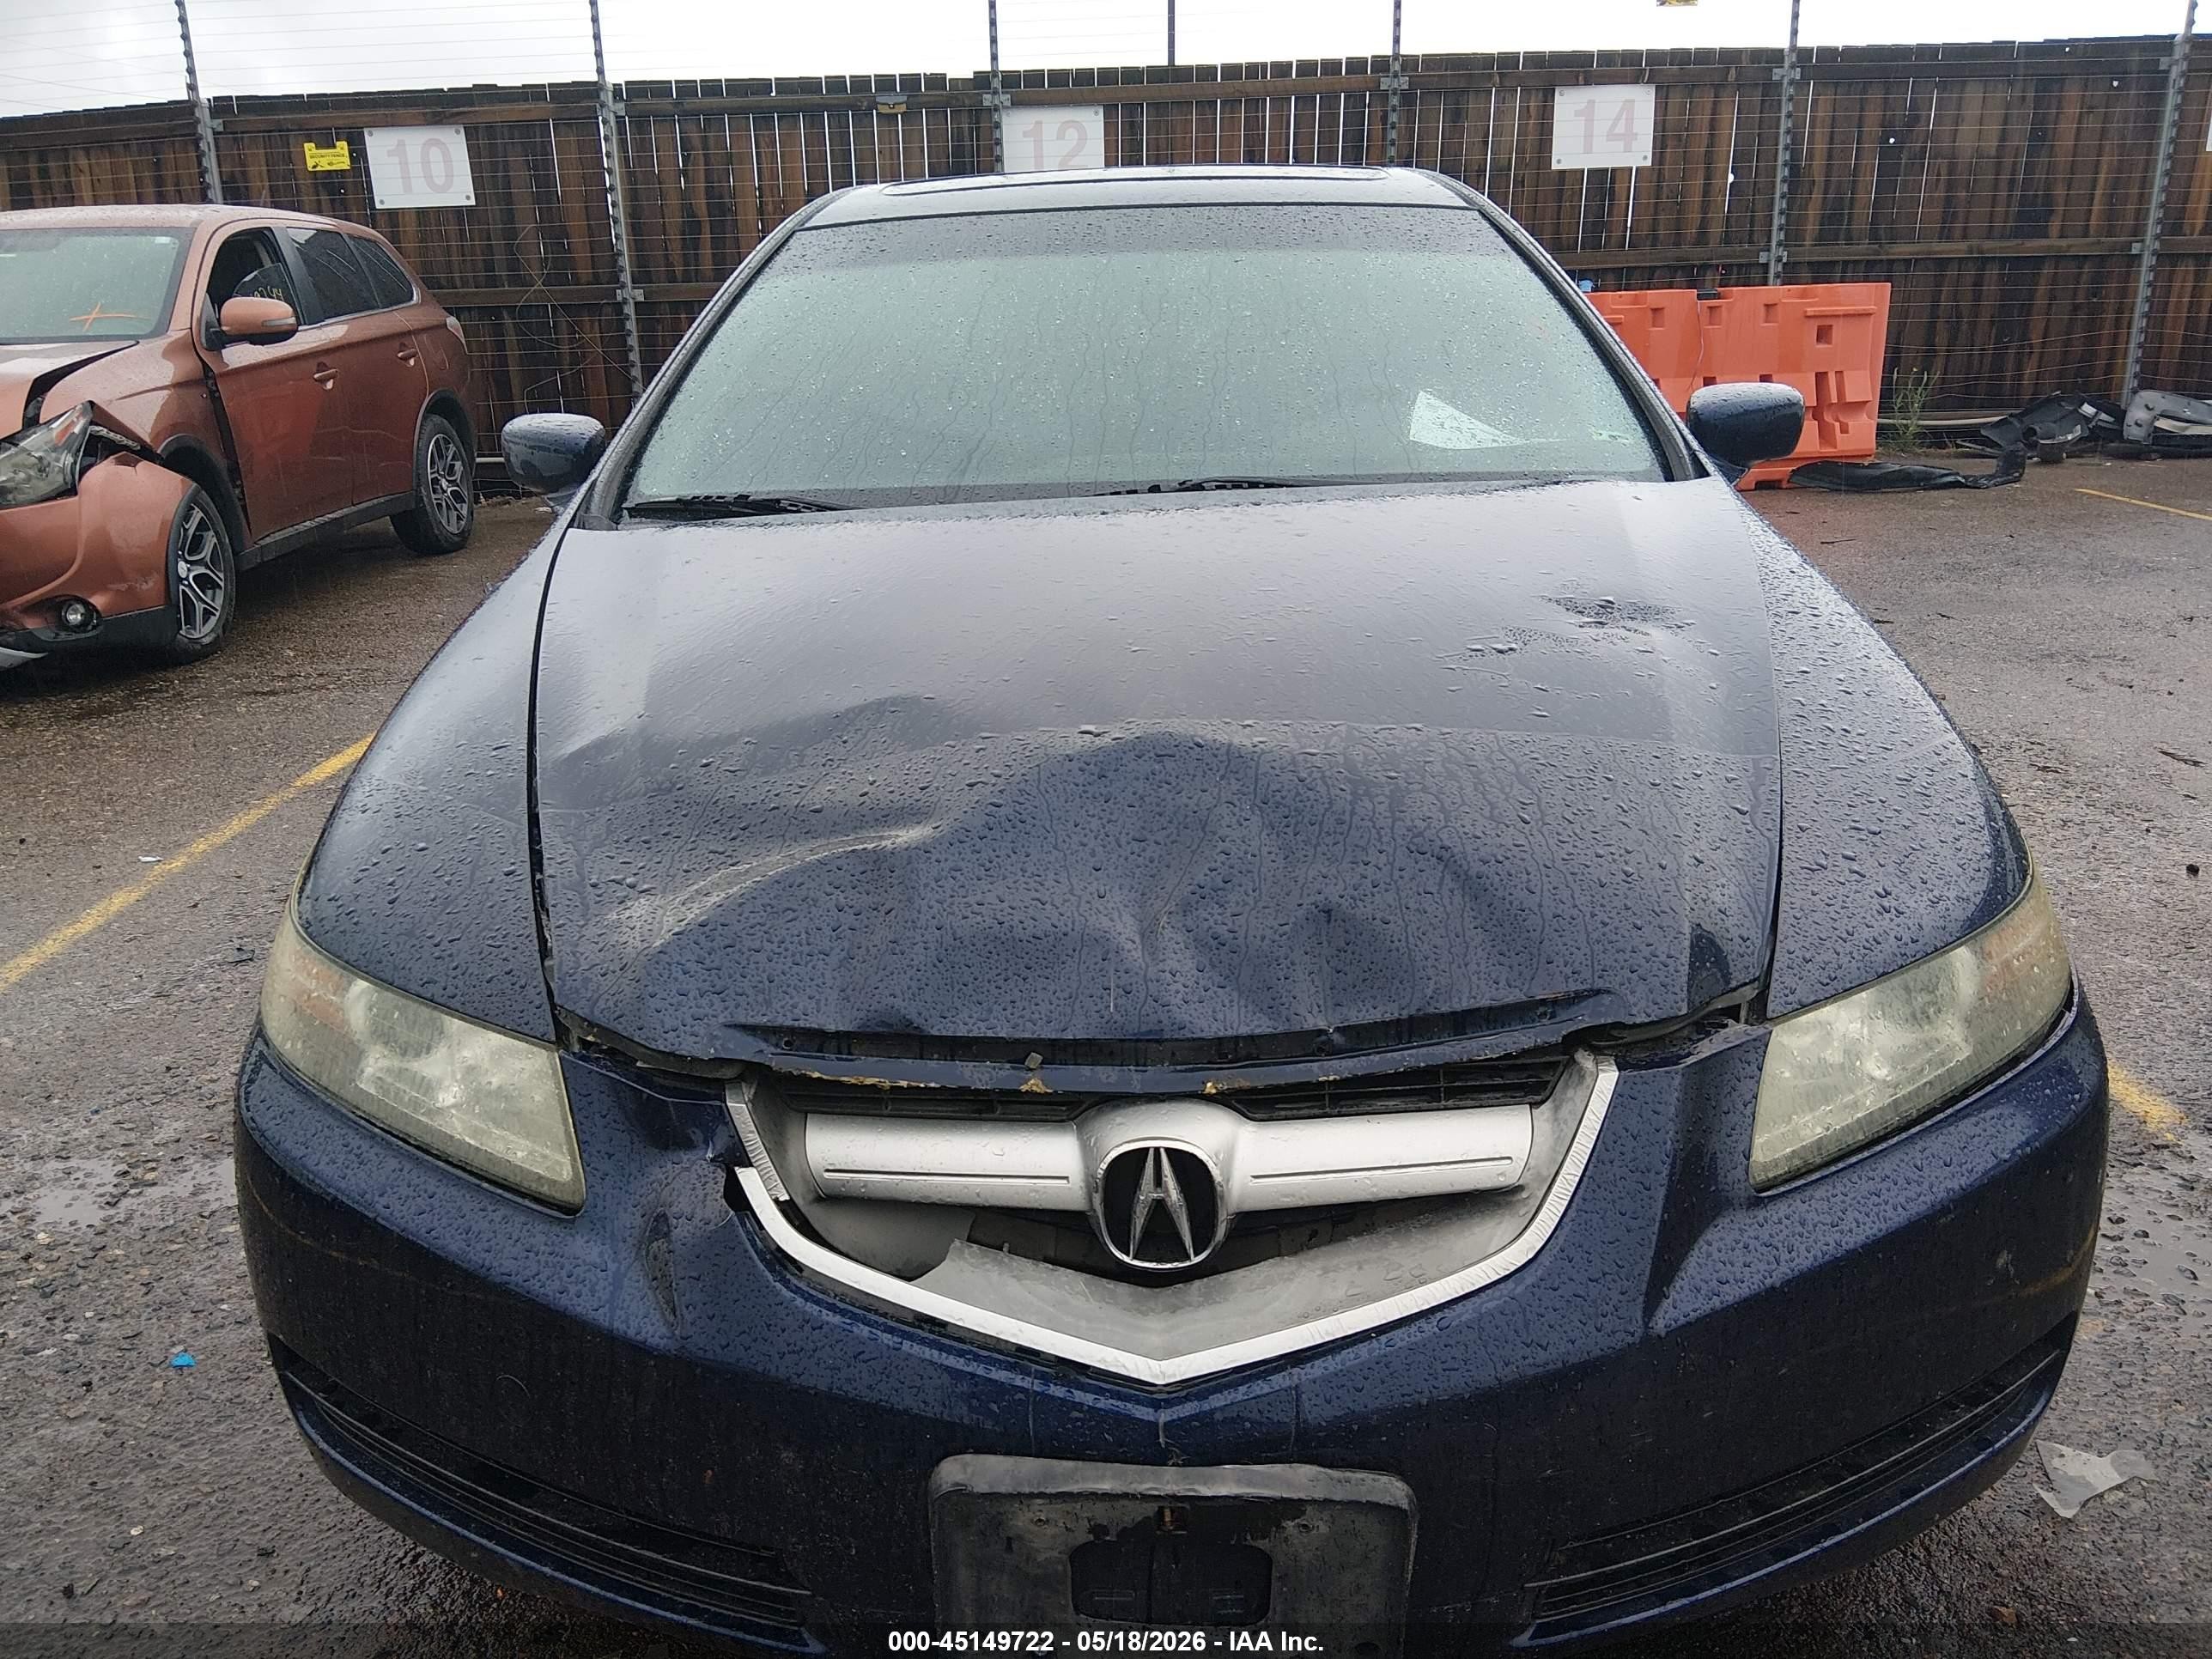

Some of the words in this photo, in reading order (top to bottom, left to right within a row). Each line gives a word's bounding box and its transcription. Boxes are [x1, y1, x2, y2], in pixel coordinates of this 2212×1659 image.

[1023, 120, 1087, 170] 12
[1574, 99, 1638, 154] 14
[386, 138, 453, 194] 10
